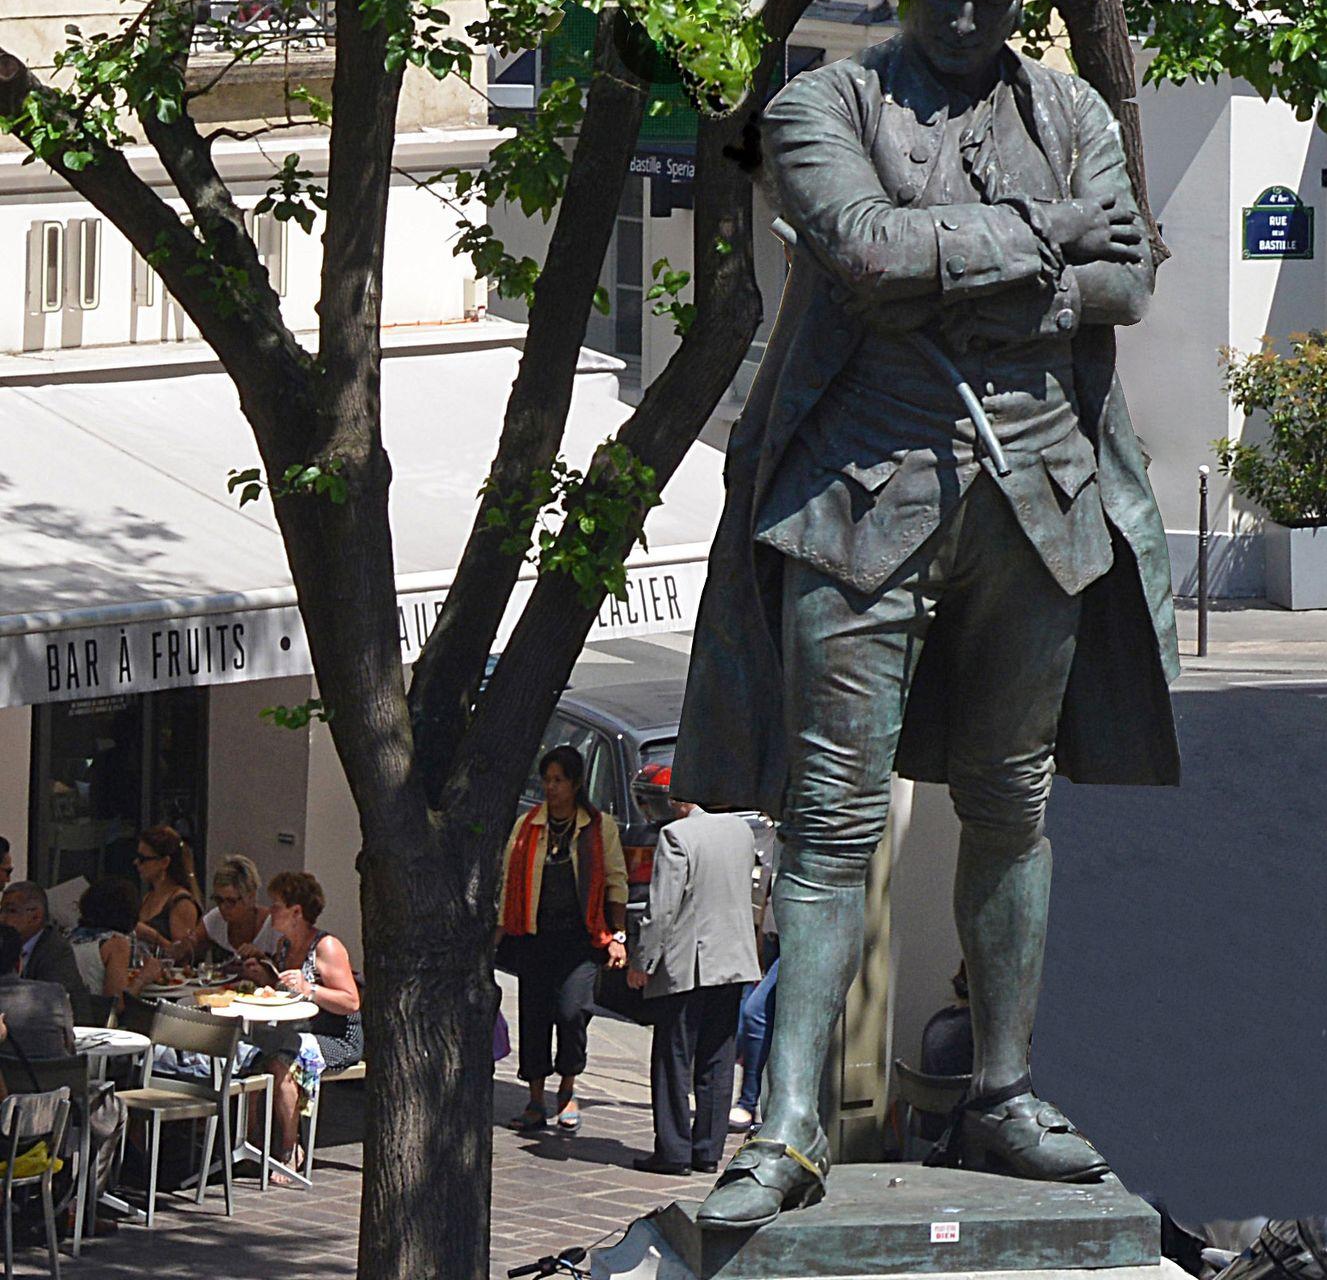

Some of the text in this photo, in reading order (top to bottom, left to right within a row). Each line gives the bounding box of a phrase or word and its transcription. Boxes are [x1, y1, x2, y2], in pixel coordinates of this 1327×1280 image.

[1269, 215, 1288, 226] RUE
[1258, 240, 1298, 251] BASTILLE
[46, 623, 245, 692] BAR À FRUITS
